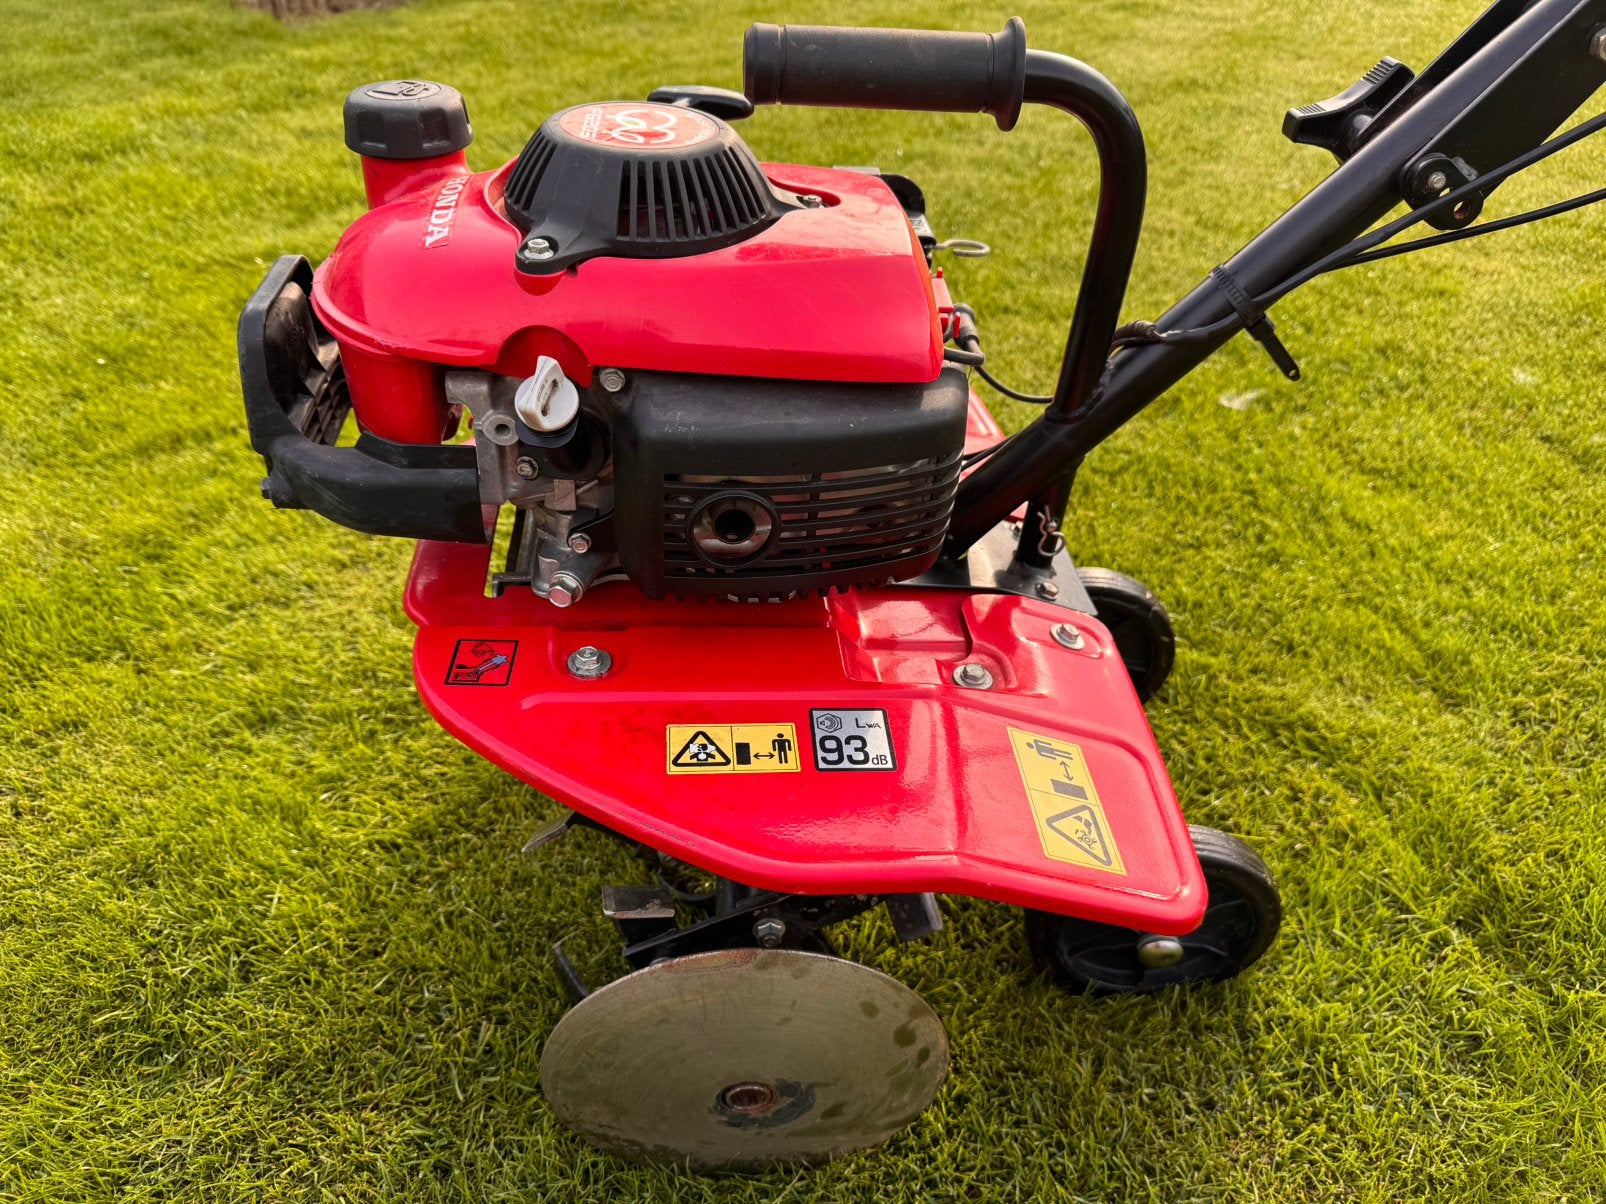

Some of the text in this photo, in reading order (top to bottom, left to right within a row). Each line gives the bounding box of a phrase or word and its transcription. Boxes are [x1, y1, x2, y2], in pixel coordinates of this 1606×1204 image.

[425, 176, 470, 247] HONDA
[819, 735, 889, 766] 93 dB
